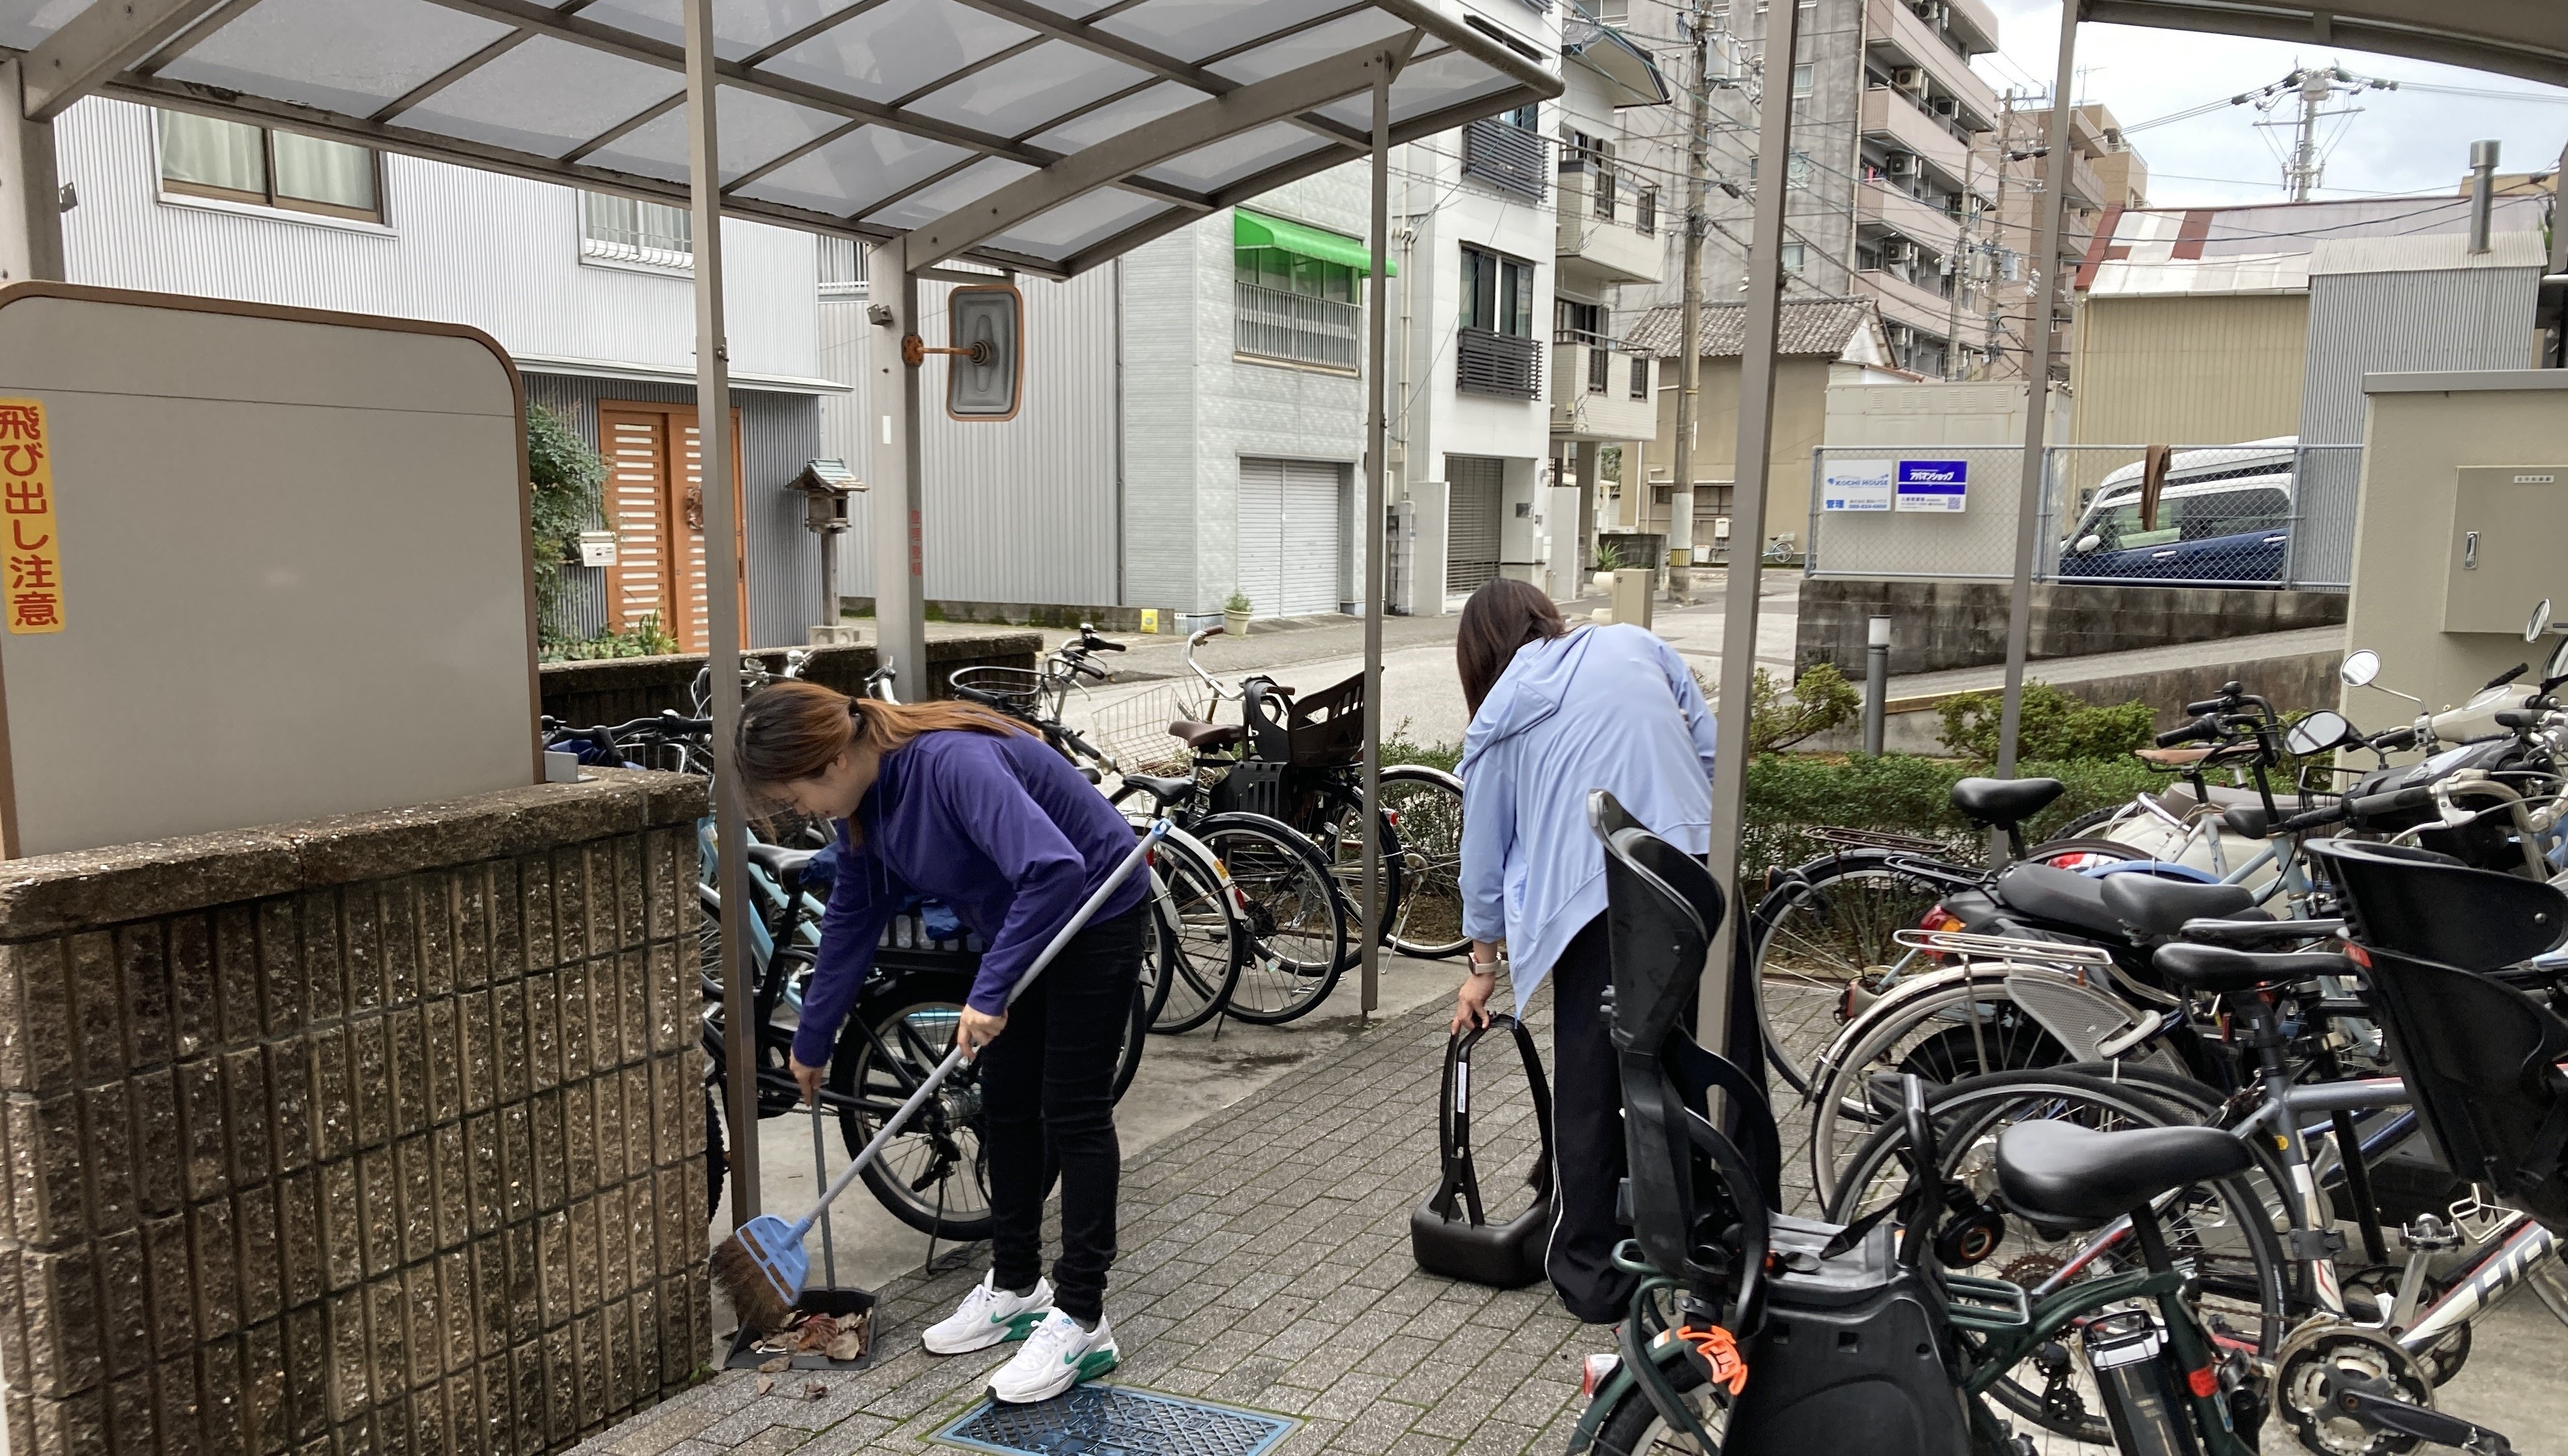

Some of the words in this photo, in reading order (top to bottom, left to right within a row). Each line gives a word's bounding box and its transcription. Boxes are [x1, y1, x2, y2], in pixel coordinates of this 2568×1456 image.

[0, 406, 59, 626] 飛び出し注意
